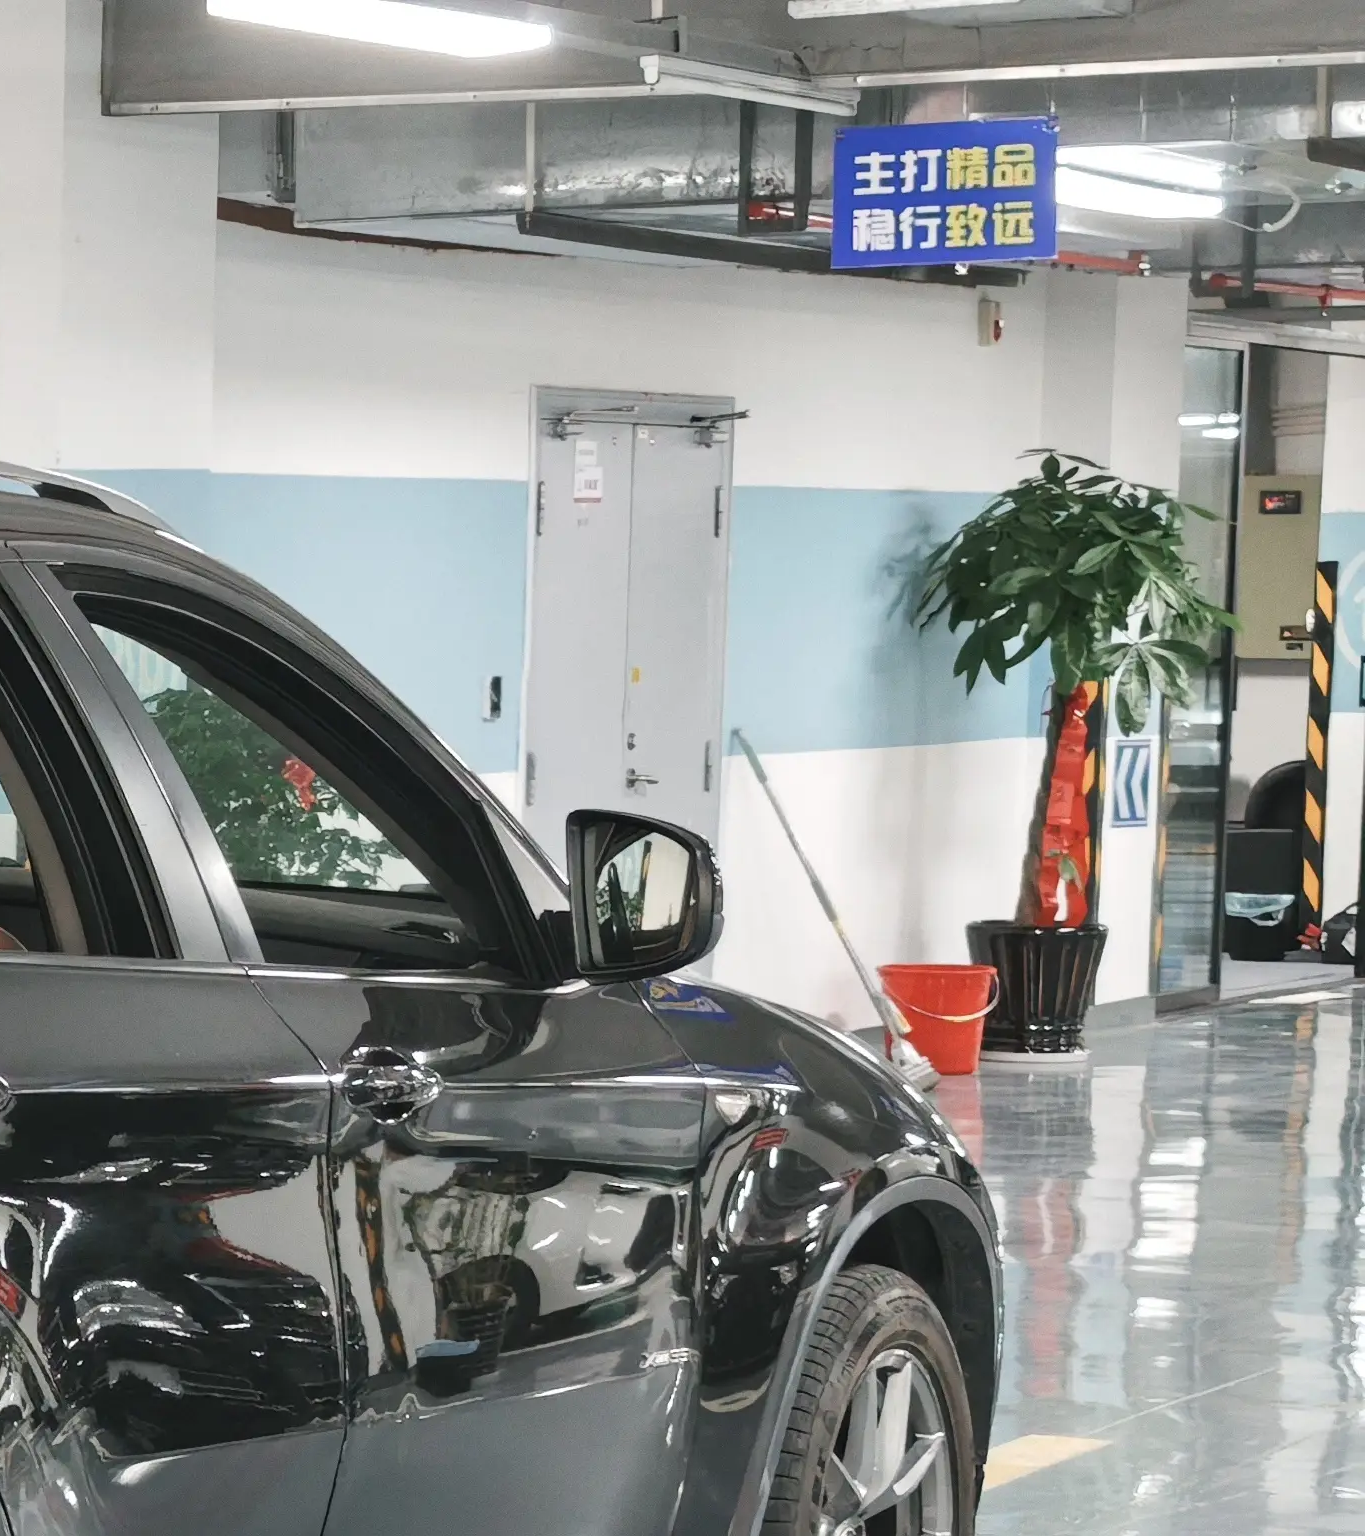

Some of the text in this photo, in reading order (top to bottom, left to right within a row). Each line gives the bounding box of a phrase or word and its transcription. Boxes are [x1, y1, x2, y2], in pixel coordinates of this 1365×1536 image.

[853, 144, 1036, 195] 主打精品
[852, 201, 1035, 251] 稳行致远
